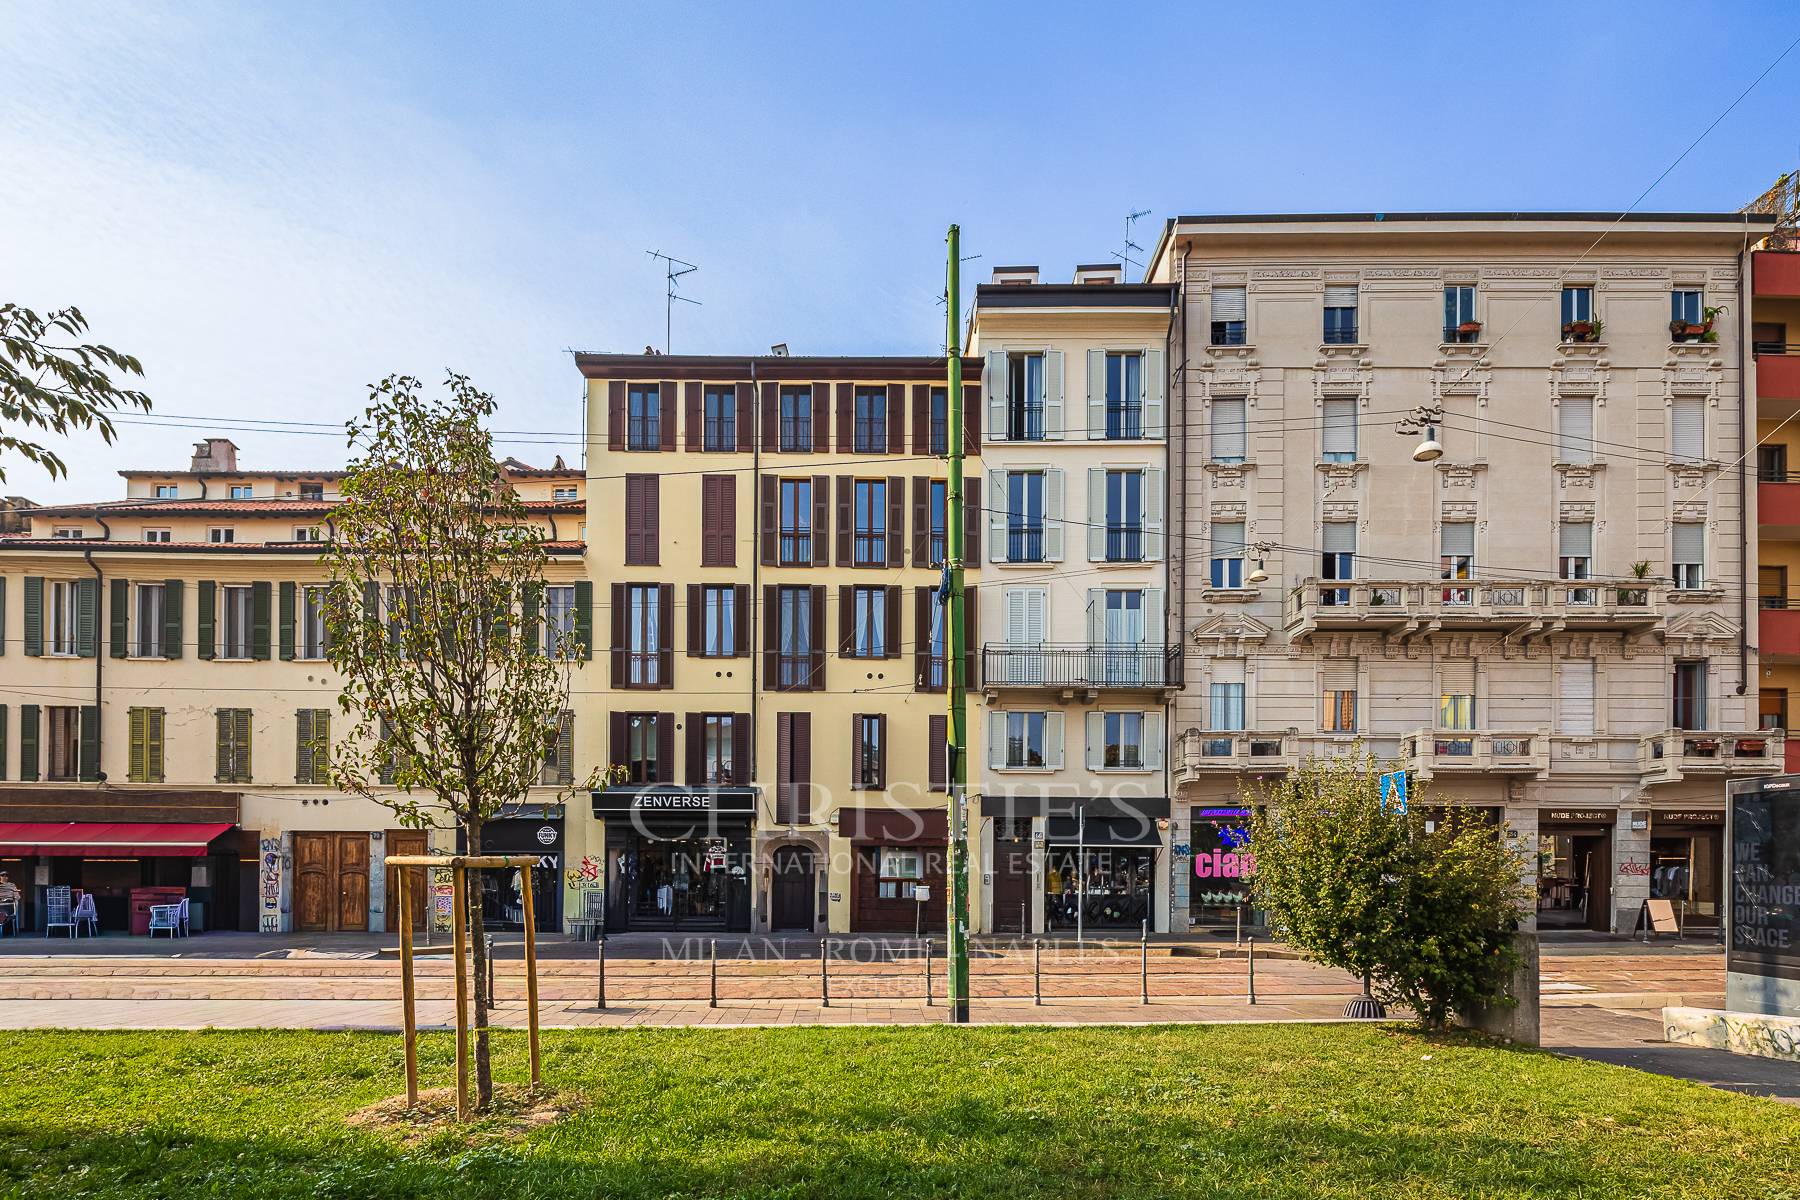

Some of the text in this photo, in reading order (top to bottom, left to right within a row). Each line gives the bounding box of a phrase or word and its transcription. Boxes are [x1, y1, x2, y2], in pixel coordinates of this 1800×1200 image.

[634, 796, 710, 807] ZENVERSE
[1735, 843, 1760, 861] WE
[1735, 905, 1769, 925] OUR
[1735, 926, 1792, 948] SPACE
